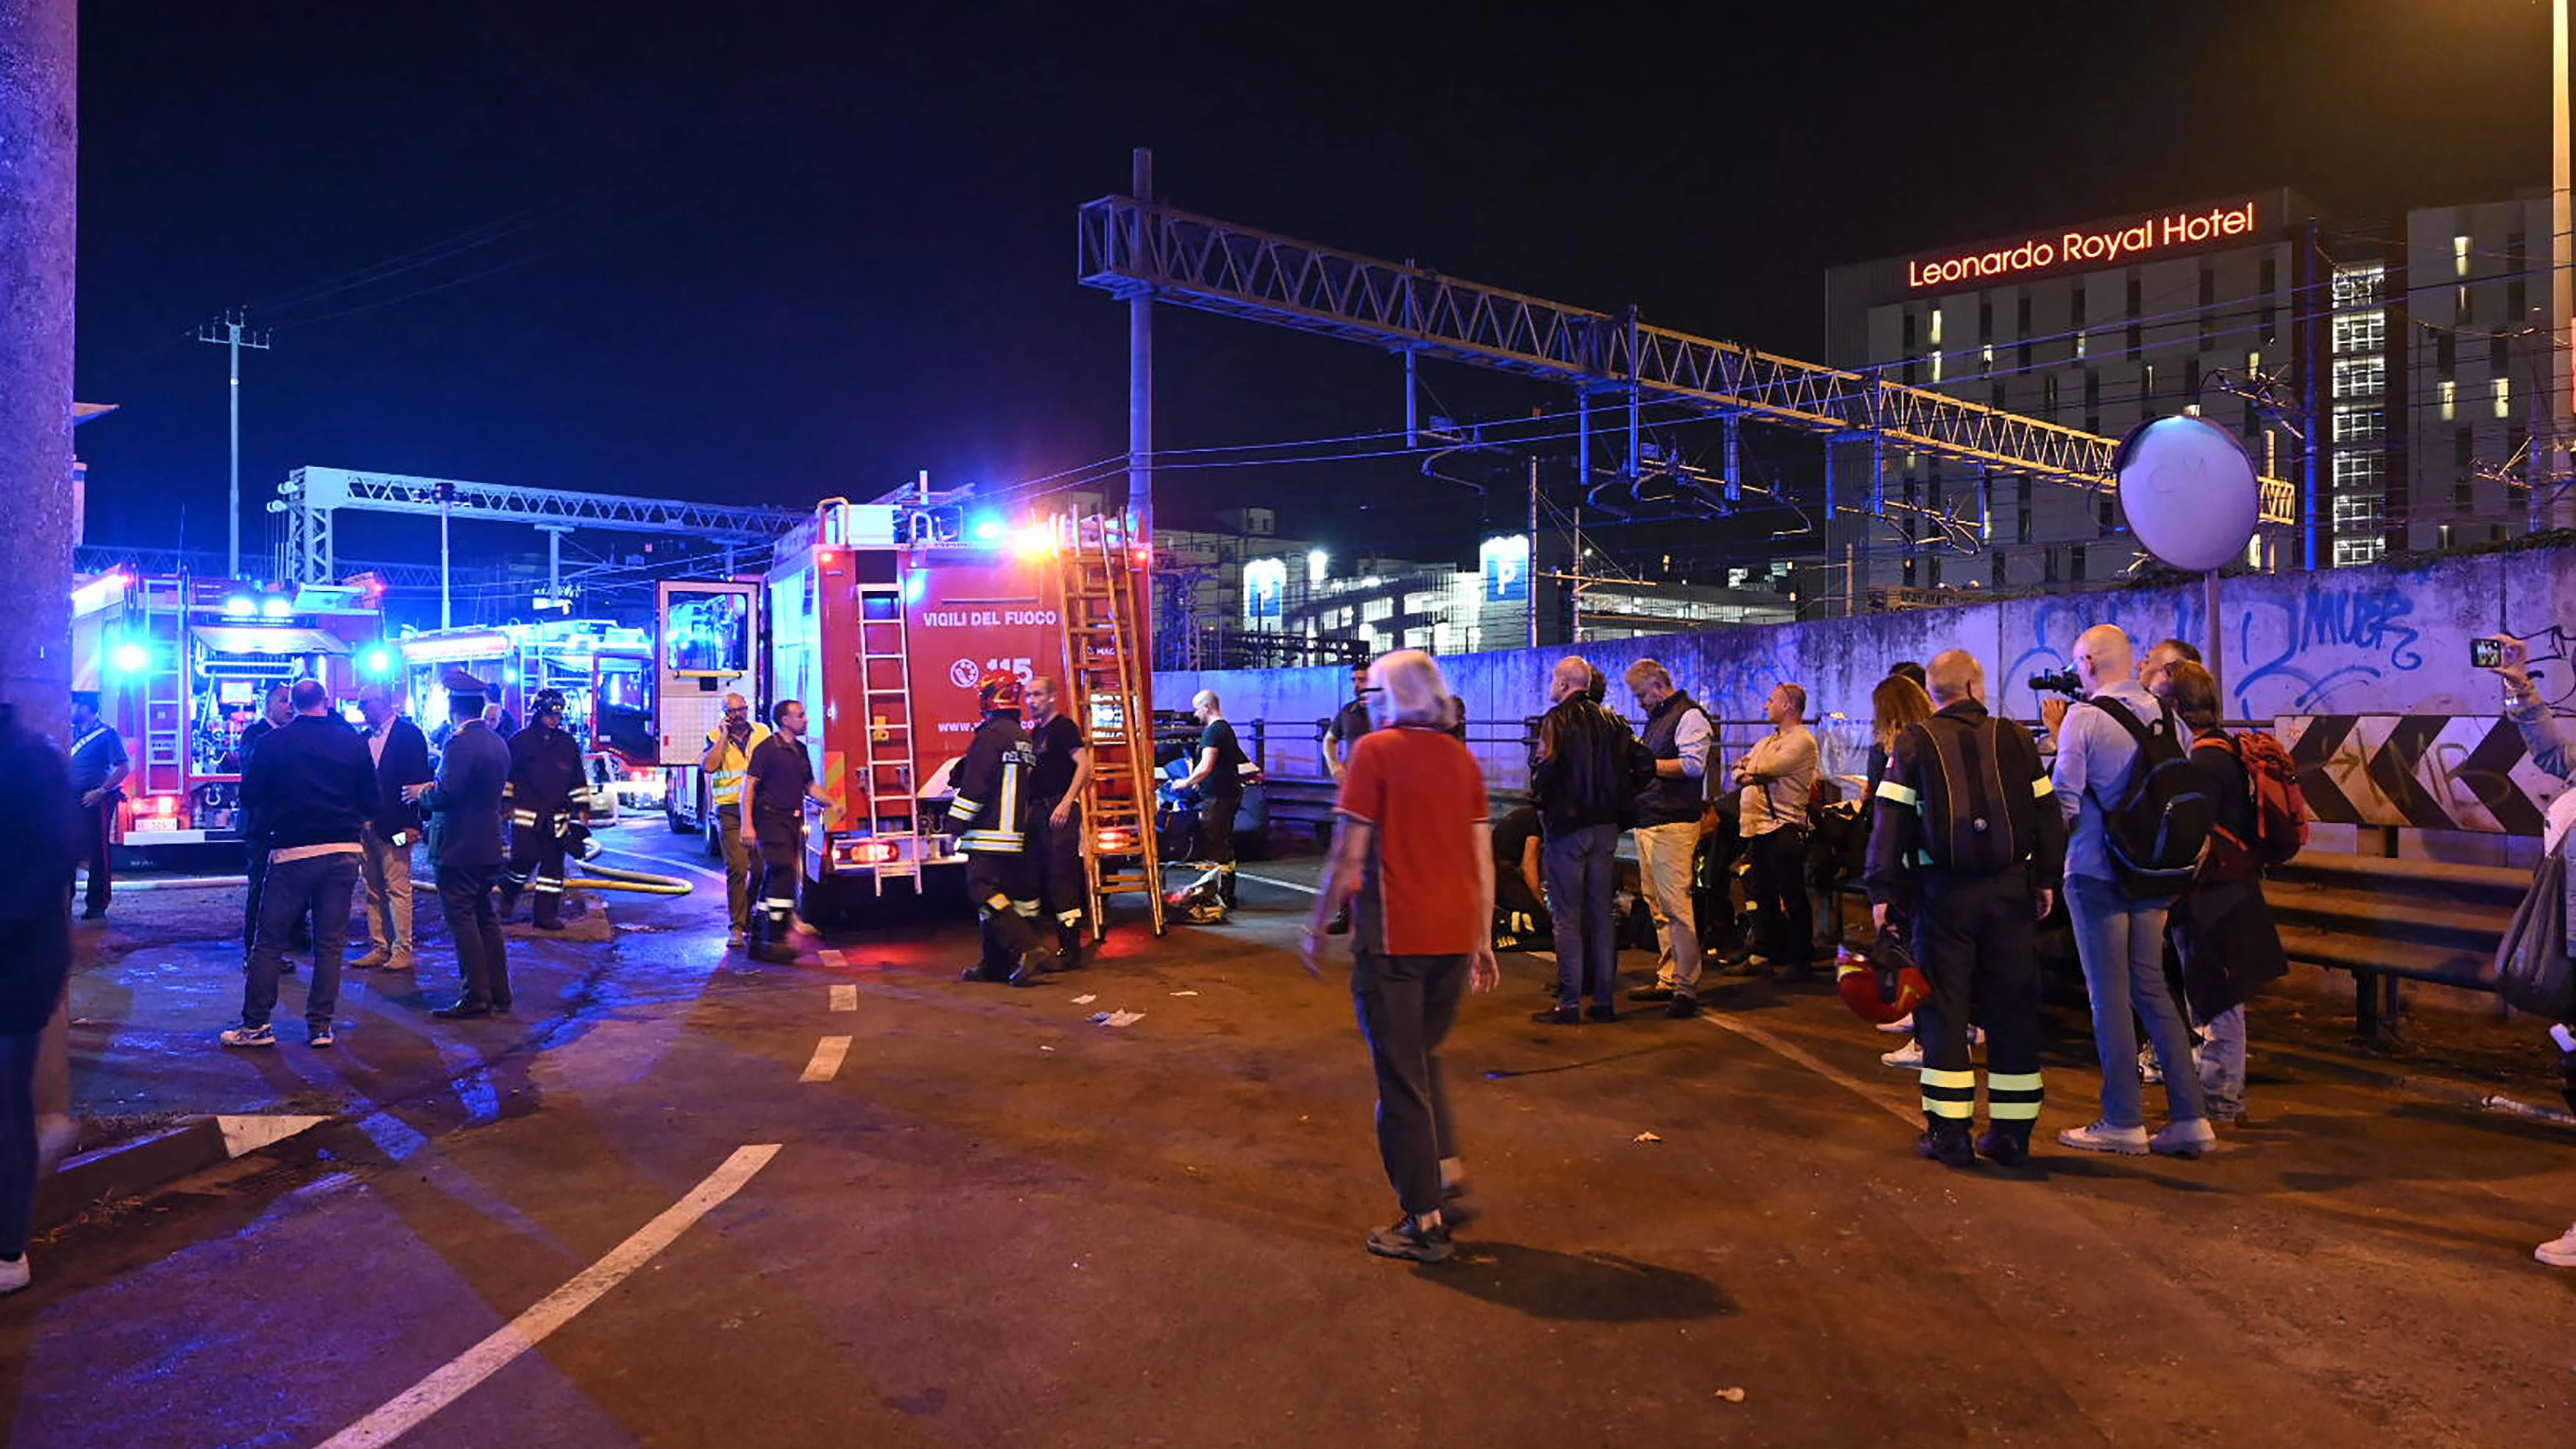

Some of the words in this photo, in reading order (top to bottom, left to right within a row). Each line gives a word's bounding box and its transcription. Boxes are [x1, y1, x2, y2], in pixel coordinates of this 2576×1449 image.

[1908, 241, 2053, 288] Leonardo
[2062, 219, 2154, 261] Royal
[2162, 202, 2255, 246] Hotel
[1497, 561, 1518, 595] P
[922, 612, 967, 627] VIGILI
[970, 612, 1001, 626] DEL
[1005, 611, 1057, 626] FUOCO
